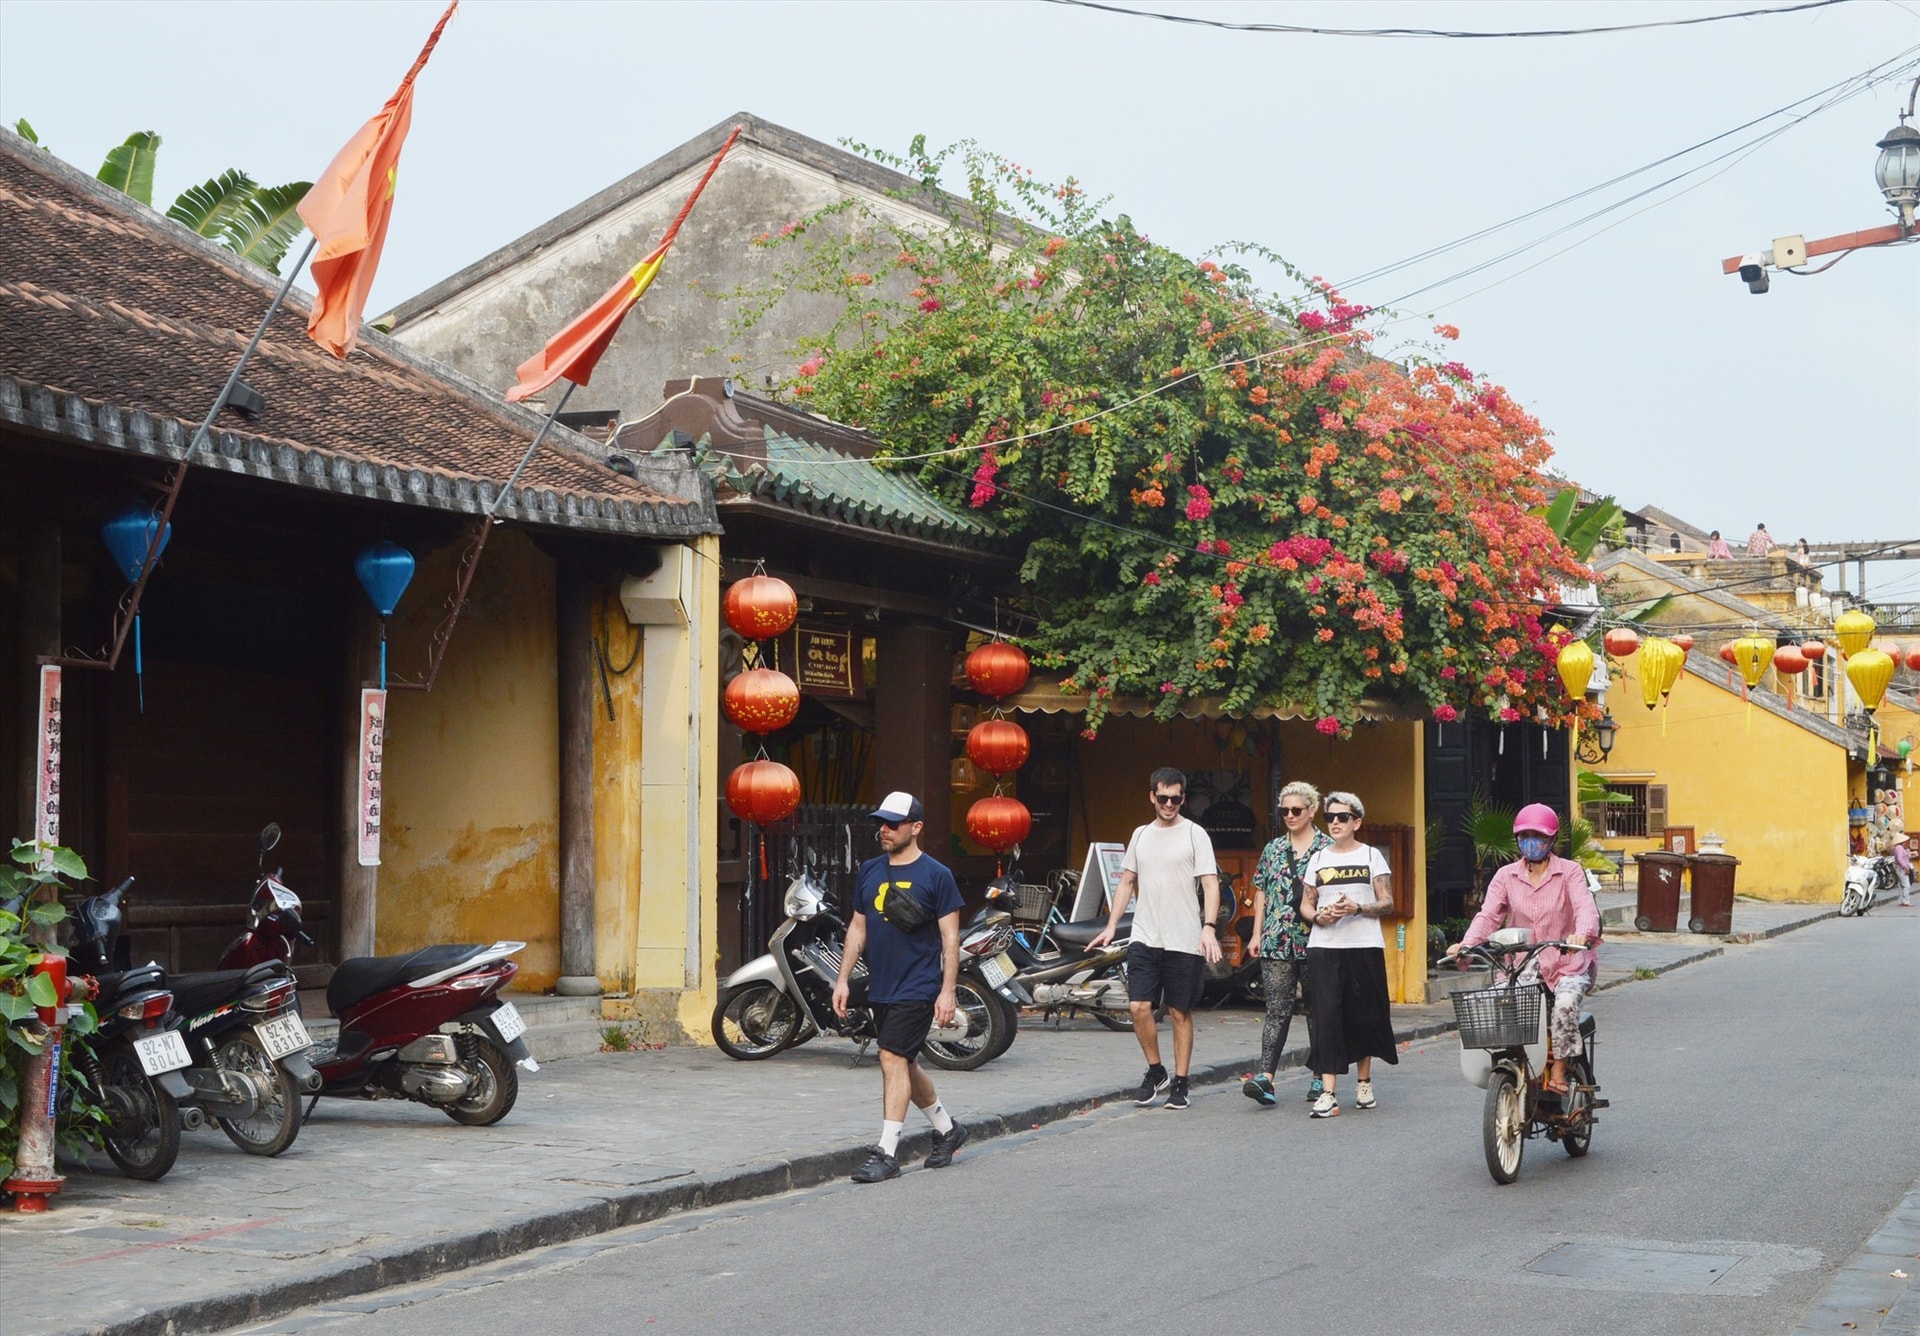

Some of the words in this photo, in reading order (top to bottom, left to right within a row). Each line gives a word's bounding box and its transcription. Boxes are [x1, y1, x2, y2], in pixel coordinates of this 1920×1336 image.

[142, 1034, 175, 1056] 92-N7
[273, 1032, 304, 1054] 8316
[150, 1056, 183, 1072] 9044
